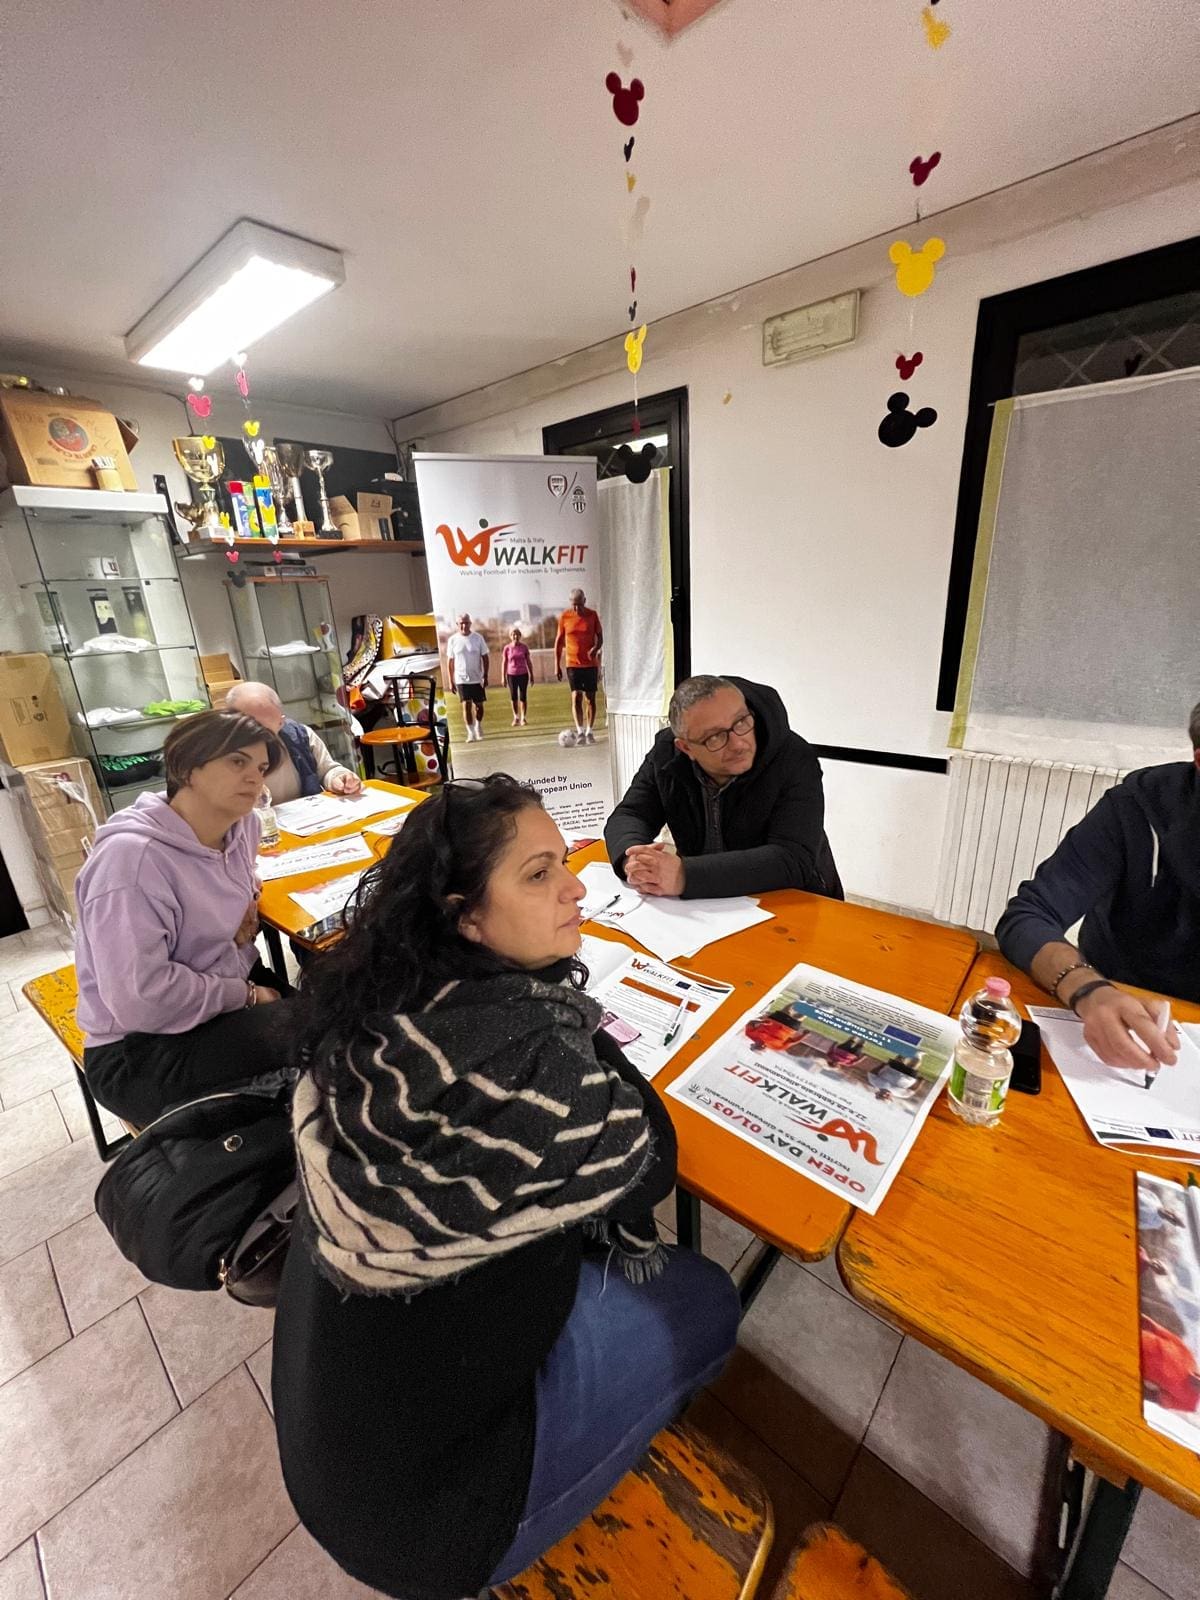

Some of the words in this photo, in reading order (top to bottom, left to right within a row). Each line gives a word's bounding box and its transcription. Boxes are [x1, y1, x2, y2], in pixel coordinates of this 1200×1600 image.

[494, 545, 588, 566] WALKFIT
[550, 566, 586, 575] Togetherness
[520, 776, 556, 787] o-funded
[818, 1016, 842, 1028] Malta
[836, 1017, 866, 1032] Giugno
[851, 1029, 884, 1046] Torneo
[705, 1087, 745, 1112] Vulnerabili
[724, 1065, 828, 1120] WALKFIT
[713, 1102, 762, 1133] 01/03
[746, 1110, 776, 1130] Giovani
[763, 1133, 803, 1157] DAY
[785, 1133, 795, 1141] 55
[796, 1140, 818, 1154] Over
[820, 1152, 850, 1172] Iscritti
[807, 1156, 865, 1192] OPEN
